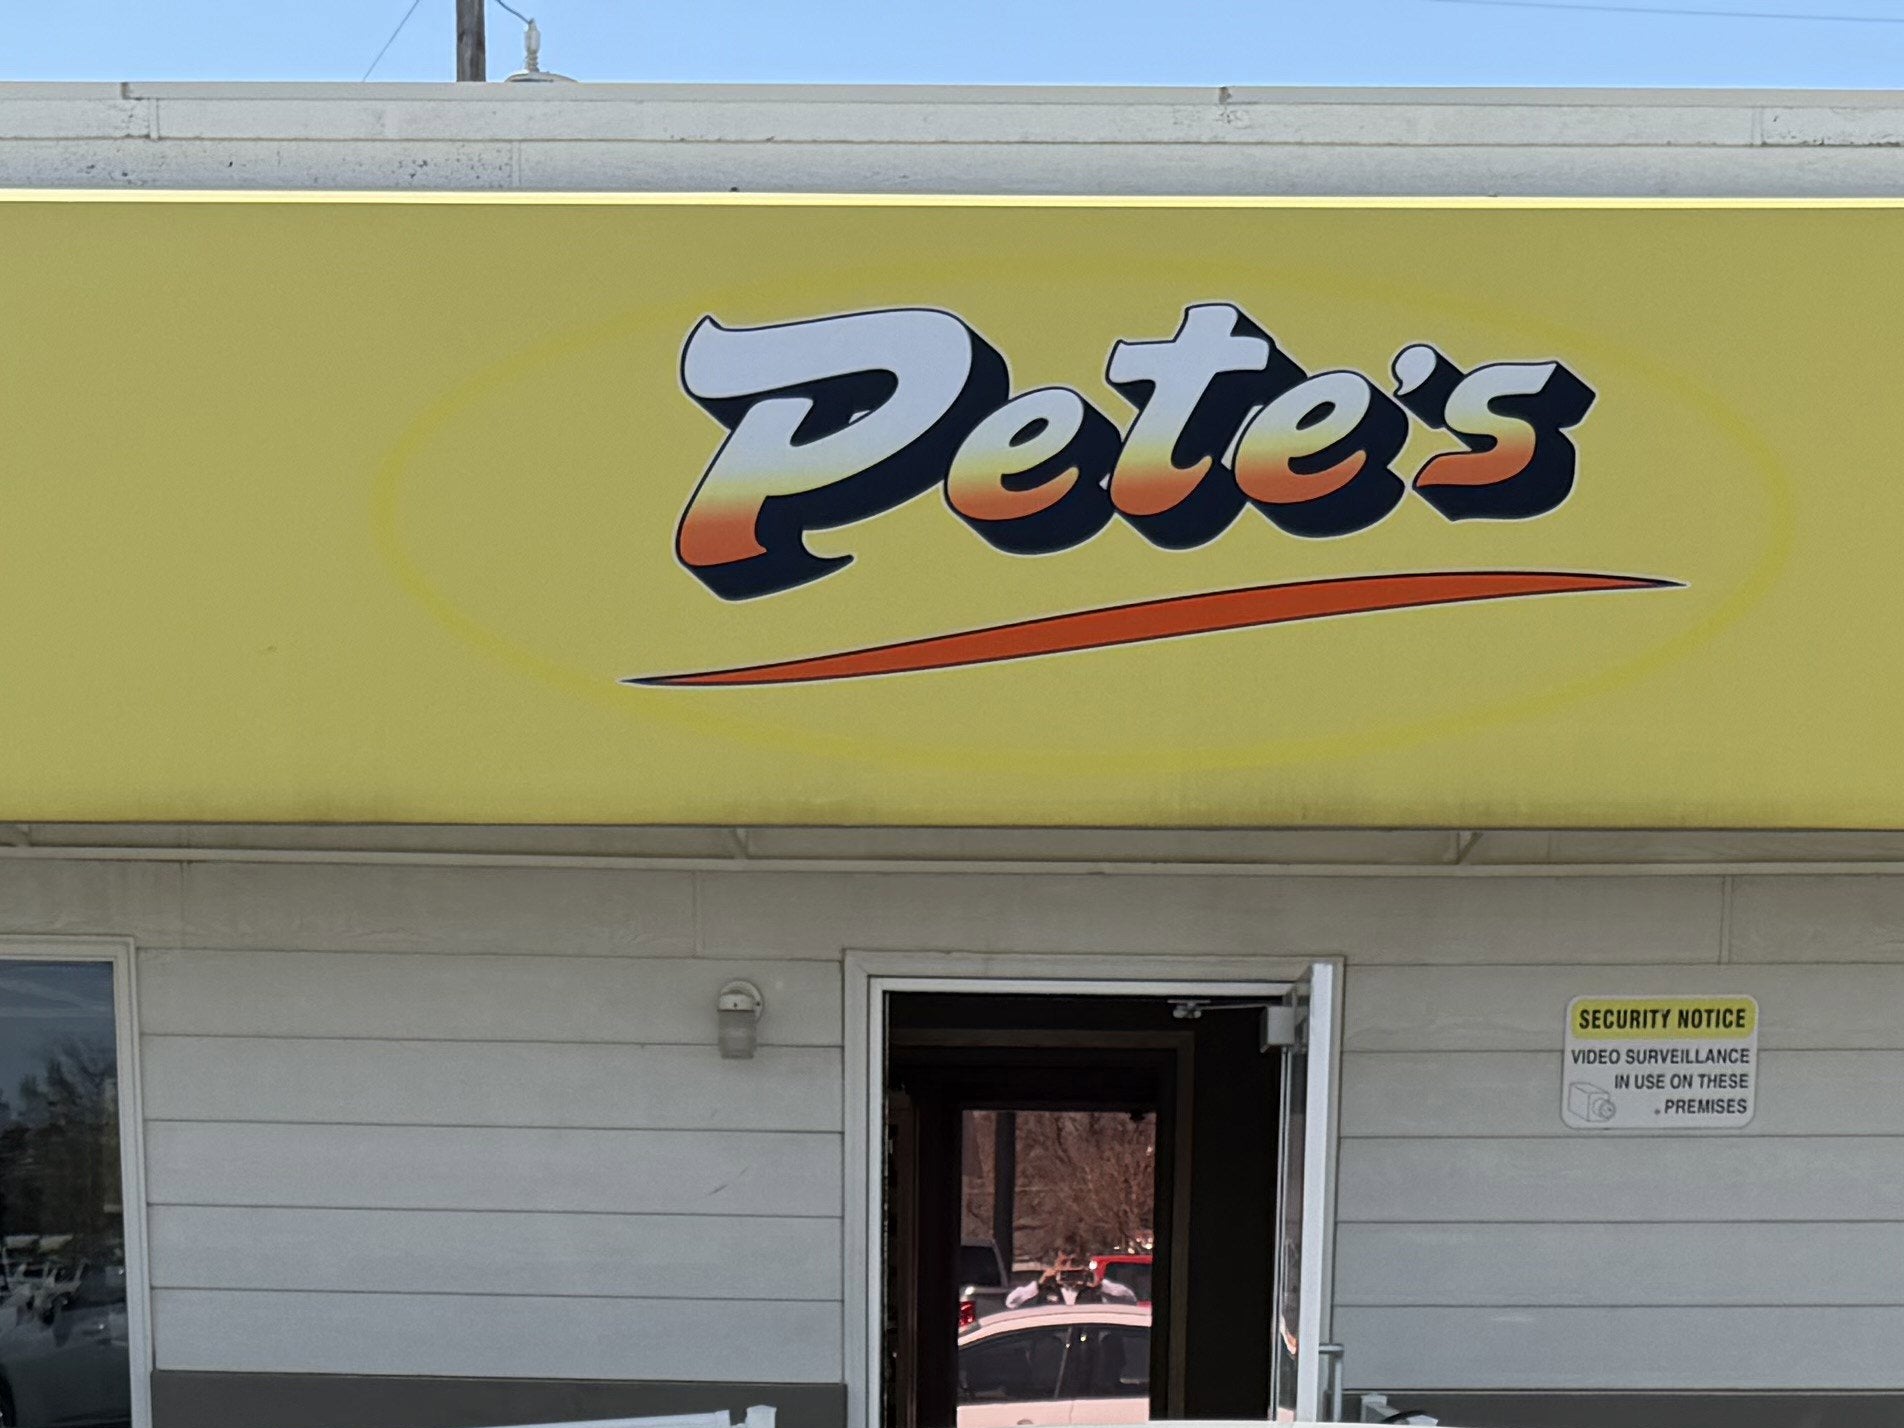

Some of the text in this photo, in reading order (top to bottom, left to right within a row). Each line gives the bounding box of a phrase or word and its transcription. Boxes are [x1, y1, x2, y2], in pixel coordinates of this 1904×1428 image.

[674, 301, 1596, 600] Pete's
[1579, 1008, 1747, 1030] SECURITY NOTICE
[1571, 1048, 1750, 1065] VIDEO SURVEILLANCE
[1614, 1073, 1749, 1090] IN USE ON THESE
[1664, 1097, 1748, 1115] PREMISES
